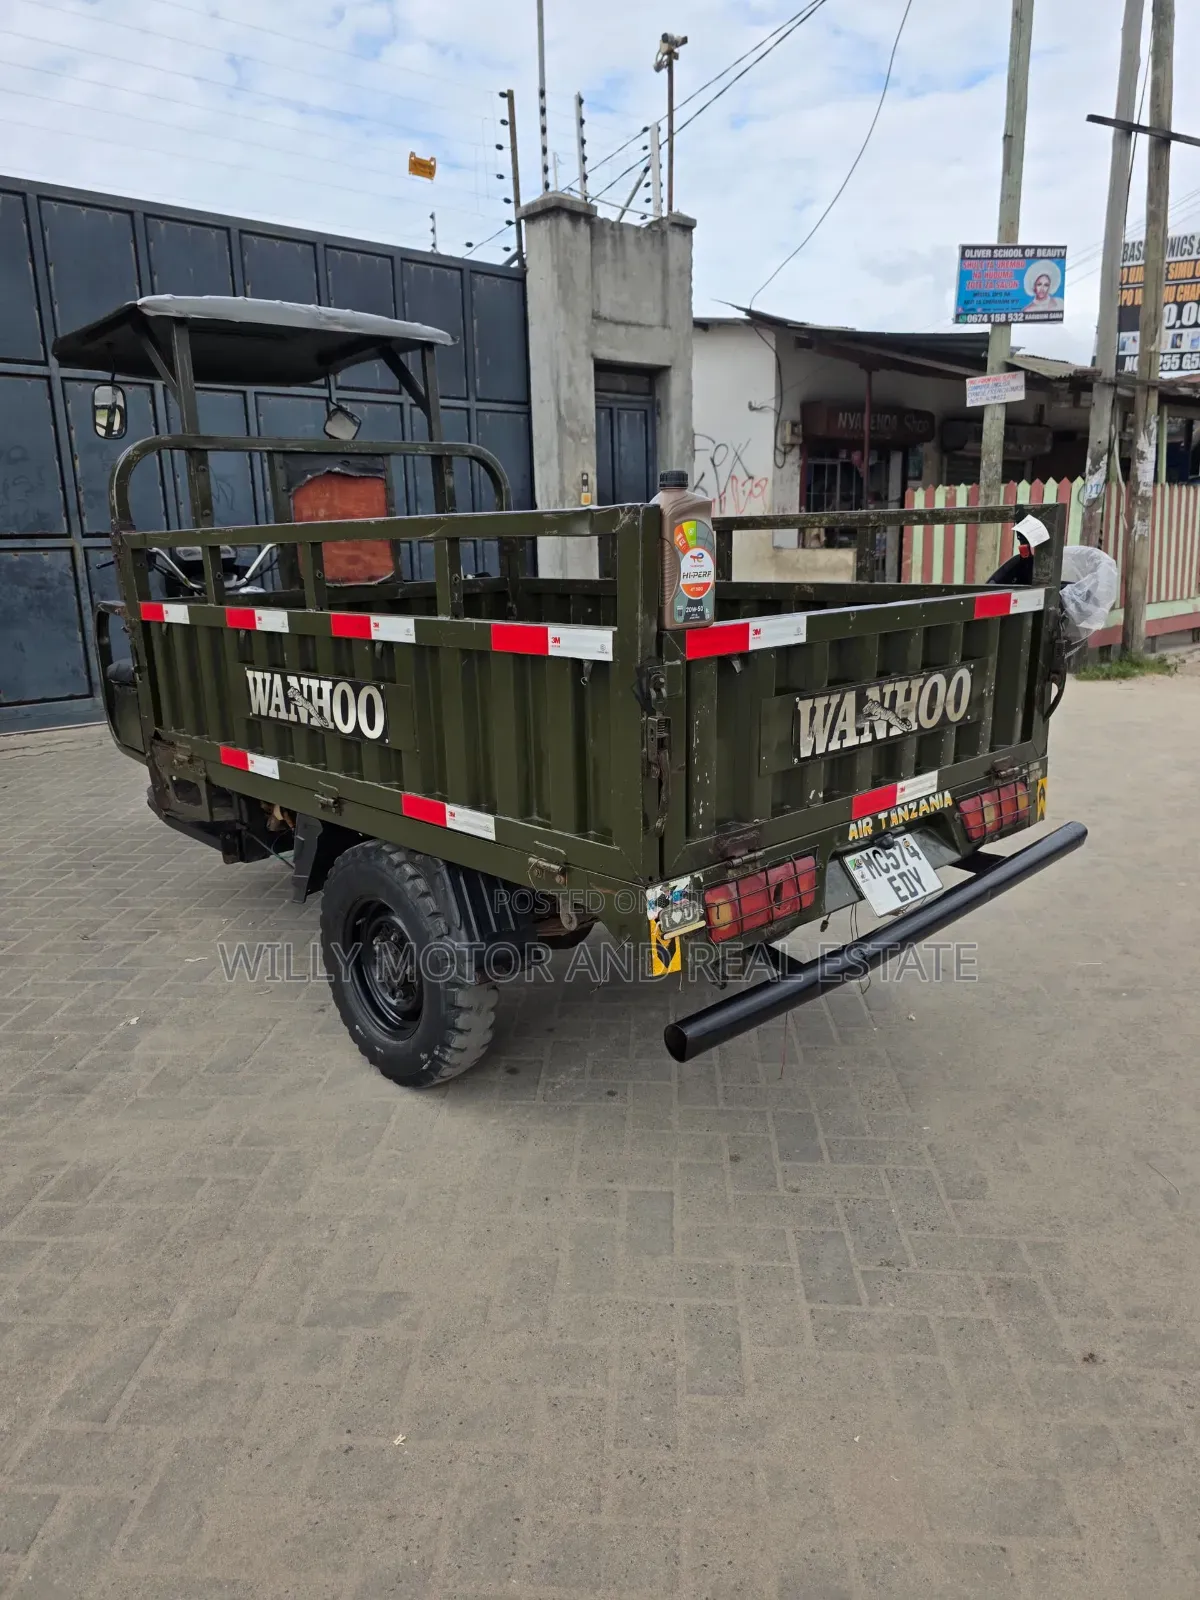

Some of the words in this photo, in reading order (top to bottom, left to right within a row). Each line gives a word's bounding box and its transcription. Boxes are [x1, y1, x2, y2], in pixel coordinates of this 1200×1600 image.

[965, 248, 992, 258] OLIVER
[993, 248, 1023, 258] SCHOOL
[1024, 248, 1035, 258] OF
[1036, 247, 1067, 258] BEAUTY
[1168, 260, 1195, 280] SIMU
[1008, 312, 1024, 322] 532
[1163, 302, 1200, 328] 0,0
[838, 412, 897, 430] NYAENDA
[682, 570, 712, 580] HI-PERF
[685, 605, 704, 613] 20W-50
[551, 636, 561, 645] 3M
[752, 628, 762, 636] 3M
[246, 670, 385, 740] WANHOO
[798, 667, 972, 759] WANHOO
[848, 817, 873, 841] AIR
[878, 790, 953, 830] TANZANIA
[860, 840, 922, 880] MC574
[887, 866, 927, 903] EDY
